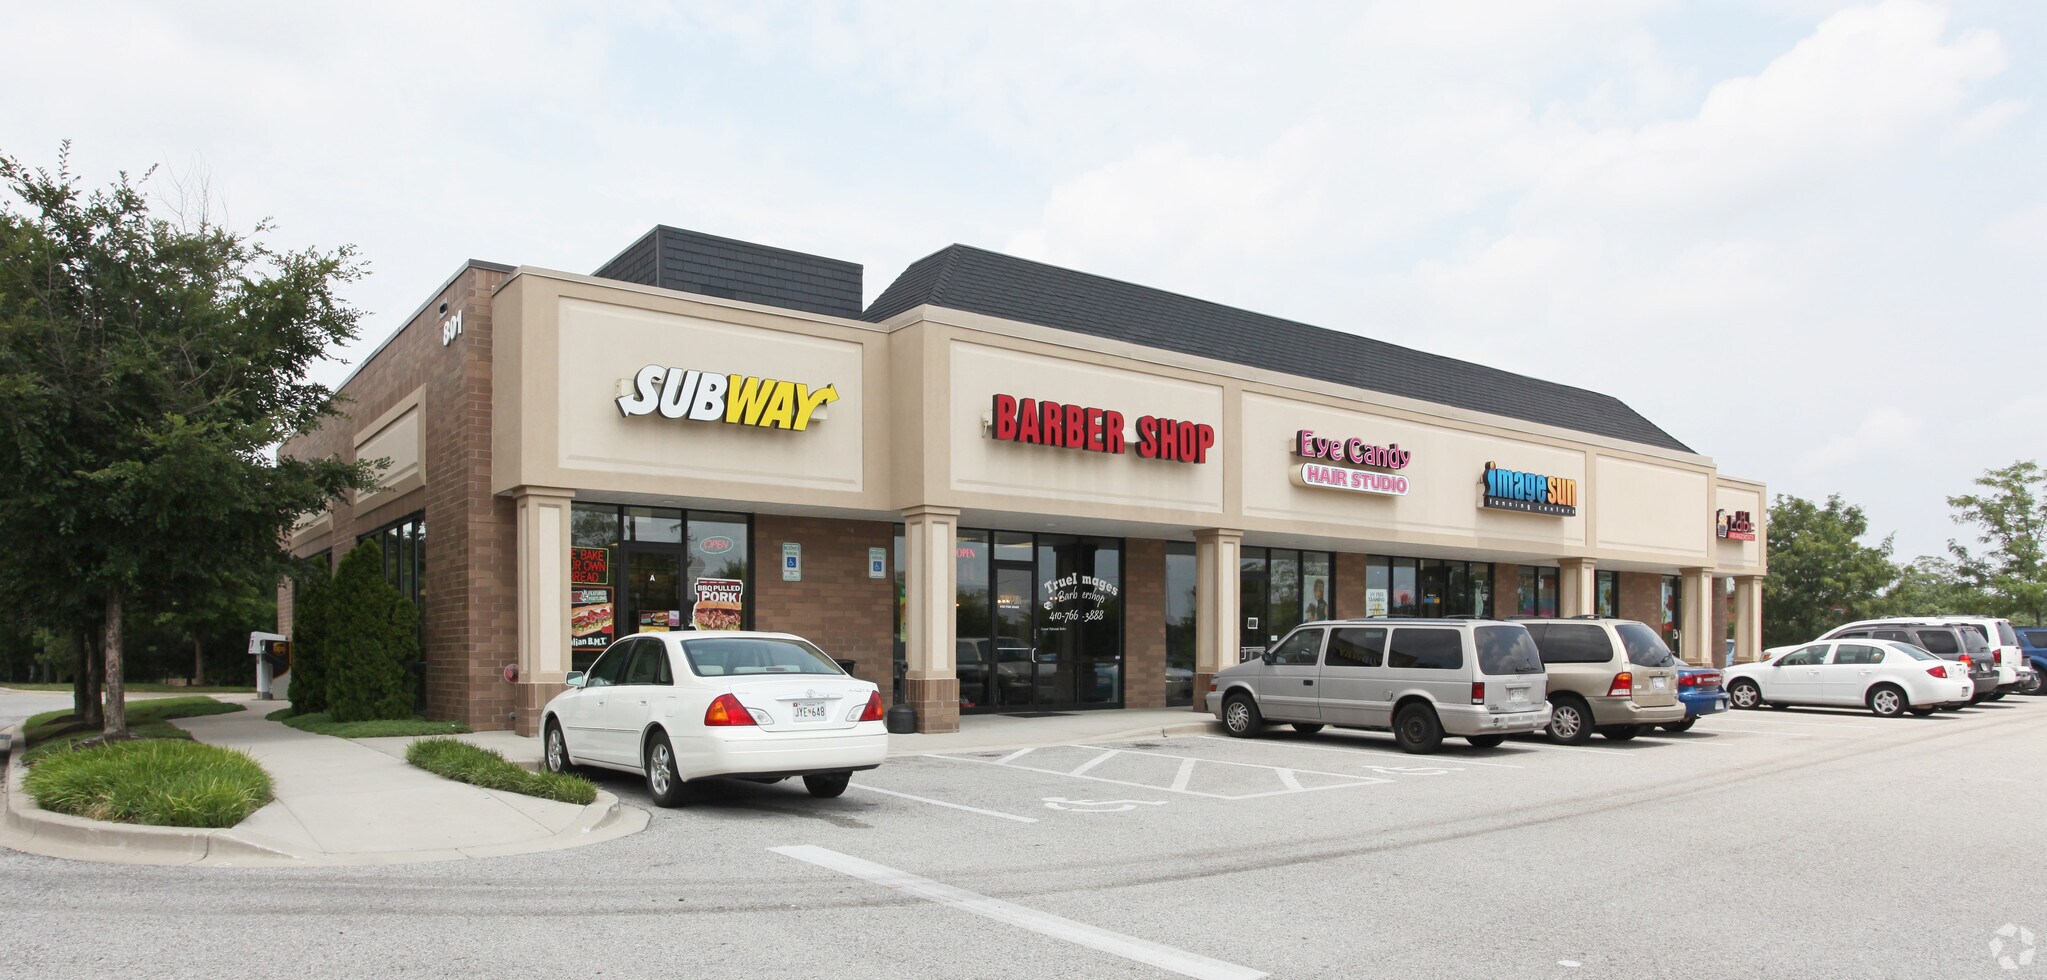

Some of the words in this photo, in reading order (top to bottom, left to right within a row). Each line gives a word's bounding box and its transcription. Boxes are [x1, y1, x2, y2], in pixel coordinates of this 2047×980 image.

[443, 310, 462, 346] 801
[615, 364, 839, 431] SUBWAY
[993, 393, 1125, 454] BARBER
[1136, 415, 1215, 464] SHOP
[1298, 430, 1342, 461] Eye
[1345, 437, 1411, 469] Candy
[1307, 465, 1348, 486] HAIR
[1351, 471, 1408, 494] STUDIO
[1489, 498, 1531, 510] tanning
[1538, 505, 1575, 515] centers
[703, 539, 729, 550] OPEN
[580, 549, 604, 561] BAKE
[957, 547, 976, 558] OPEN
[583, 560, 606, 571] OWN
[650, 574, 656, 582] A
[702, 591, 737, 602] PORK
